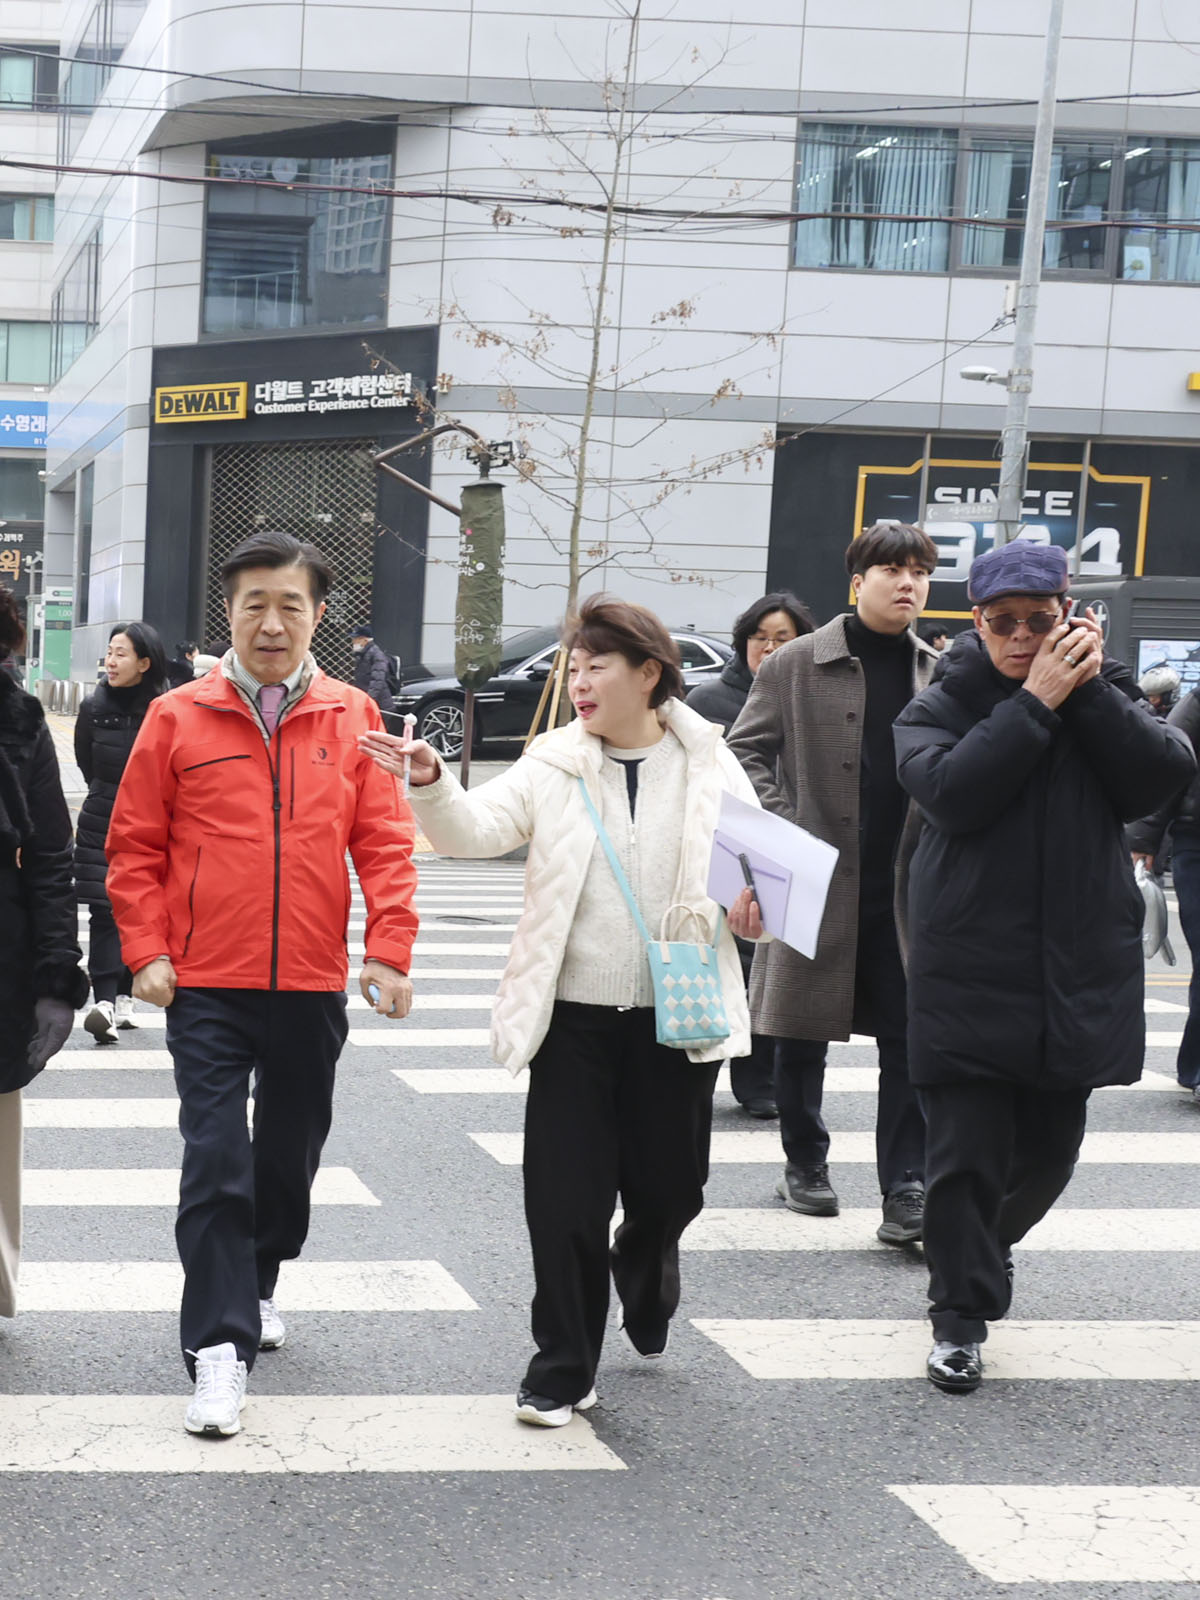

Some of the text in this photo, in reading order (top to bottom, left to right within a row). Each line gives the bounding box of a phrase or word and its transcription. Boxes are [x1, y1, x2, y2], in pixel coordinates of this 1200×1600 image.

[254, 372, 412, 401] 디월트 고객체험센터
[254, 395, 409, 415] Customer Experience Center
[0, 414, 47, 432] 수영레
